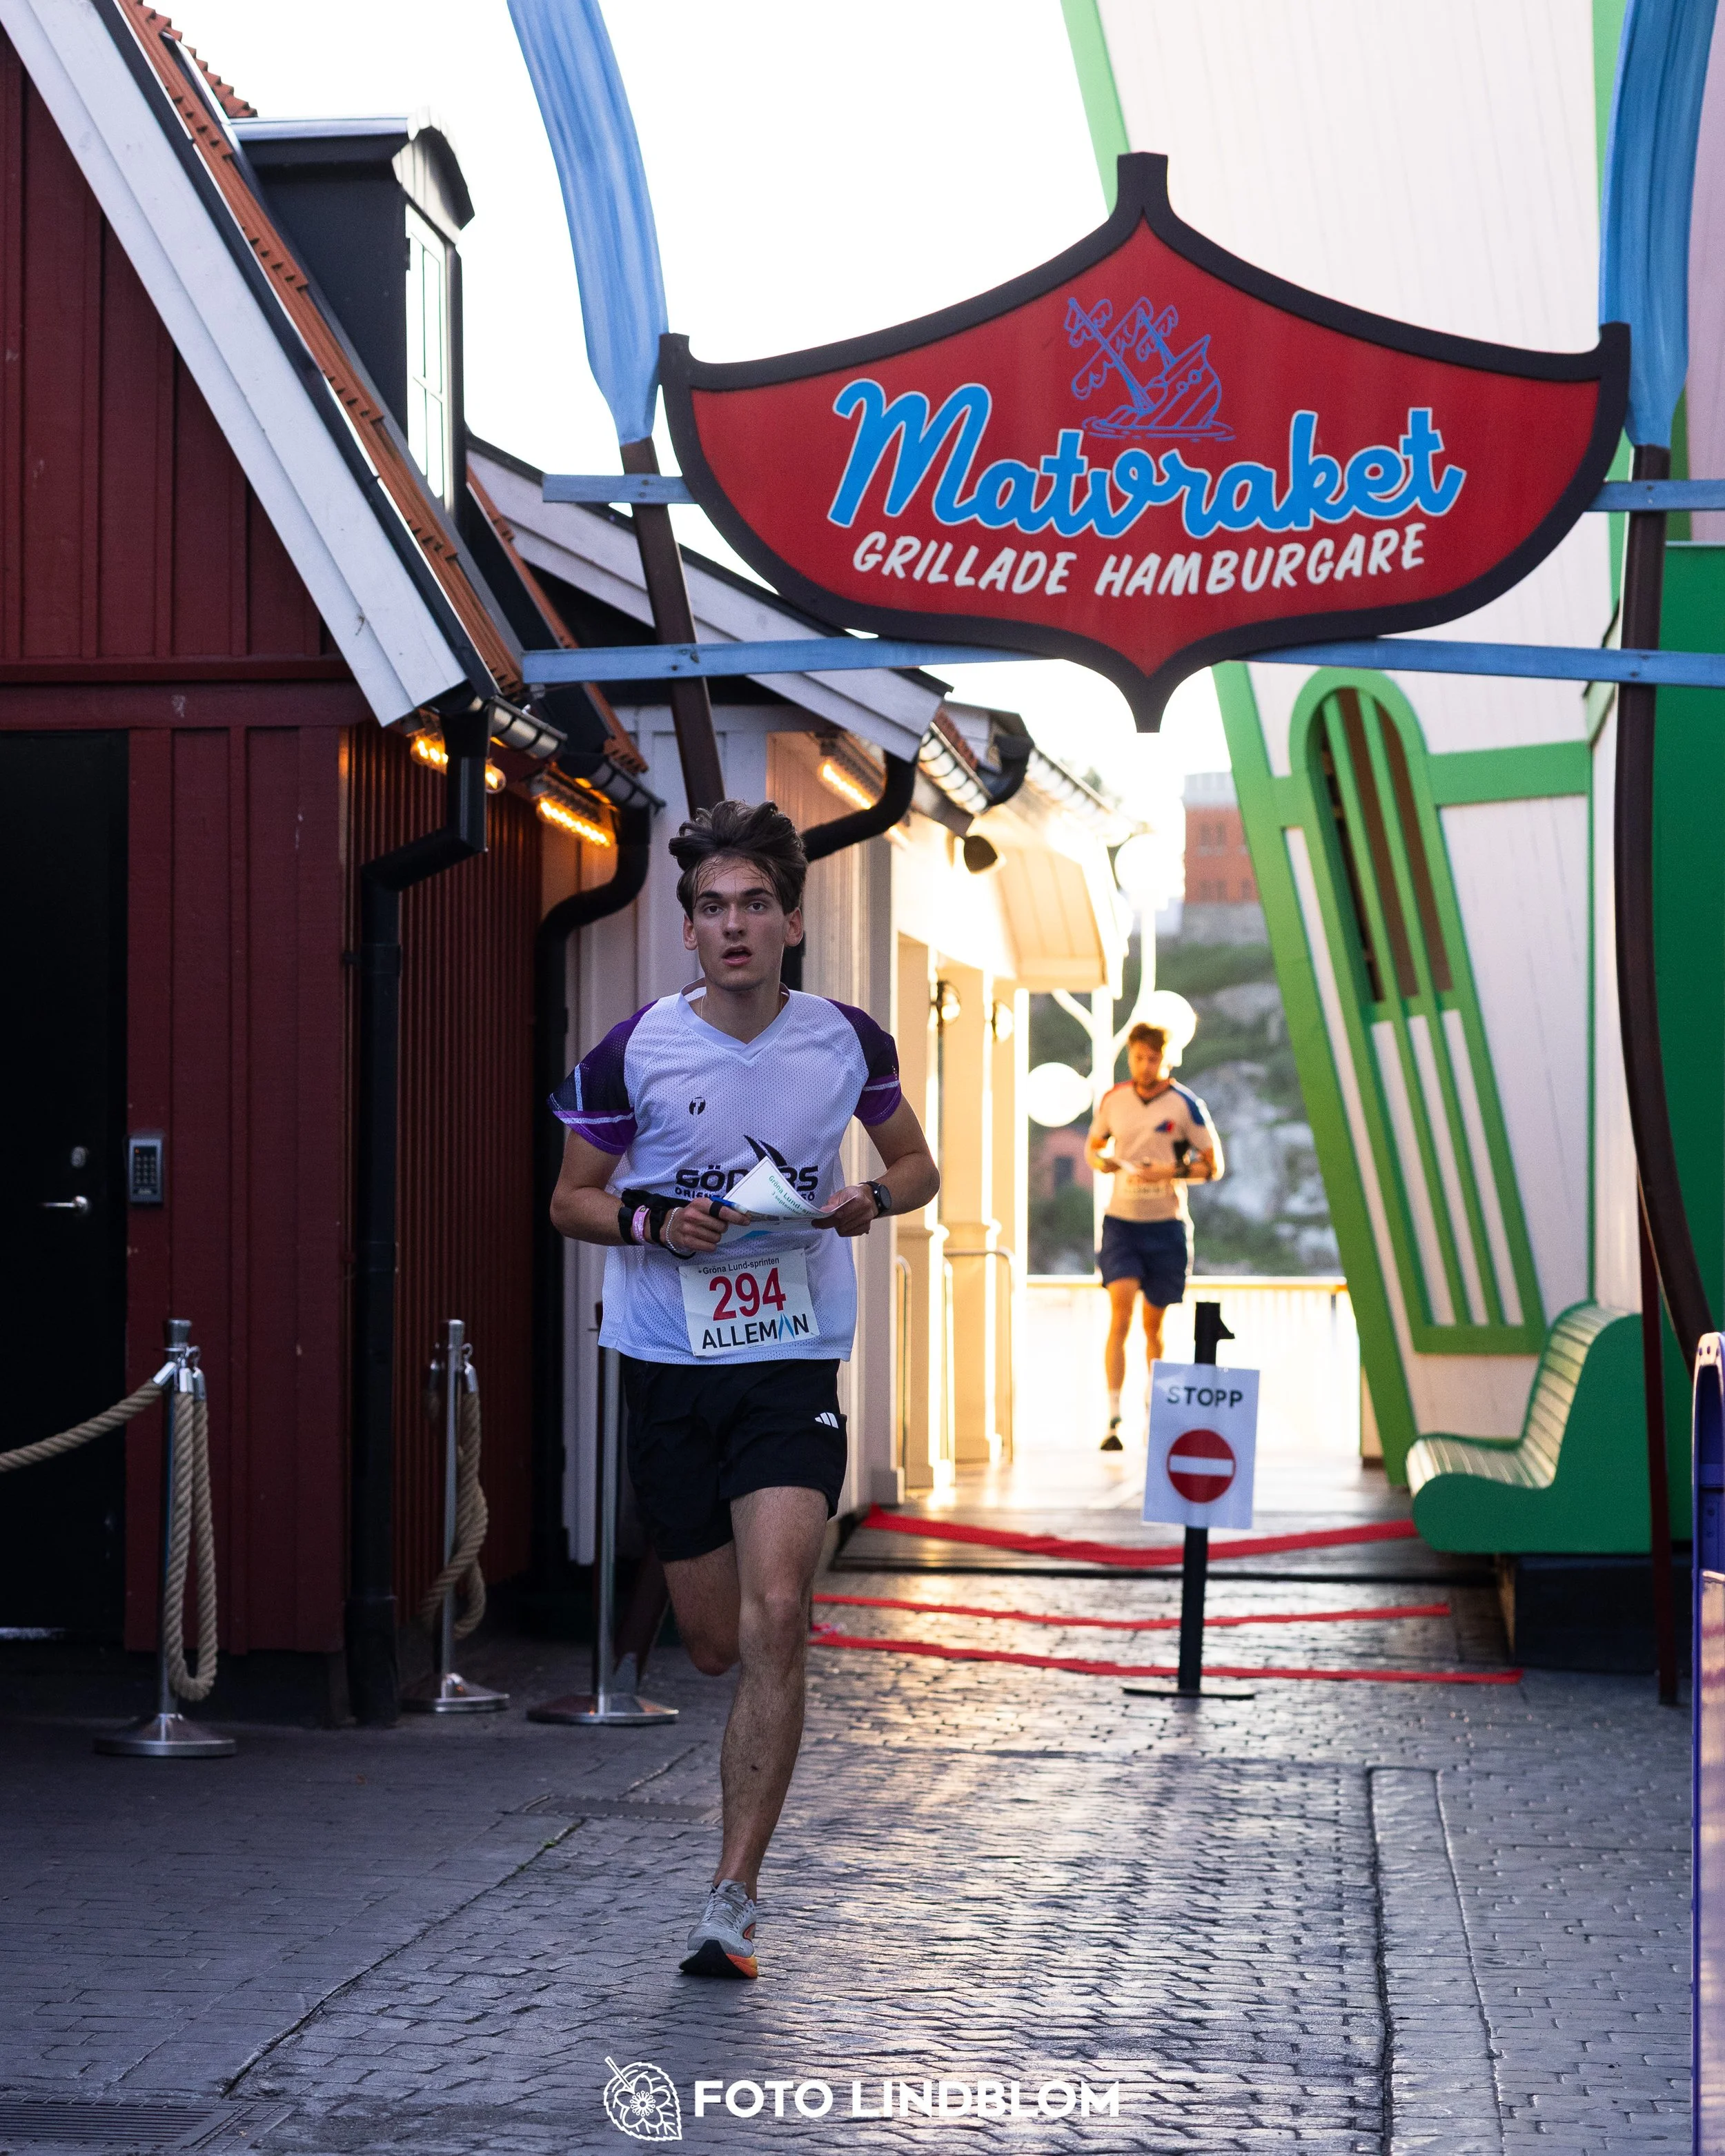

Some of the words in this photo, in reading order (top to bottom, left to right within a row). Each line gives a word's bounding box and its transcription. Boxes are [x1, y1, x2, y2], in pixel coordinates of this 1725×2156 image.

[828, 378, 1467, 539] Matvraket
[852, 531, 1077, 595] GRILLADE
[1094, 524, 1426, 597] HAMBURGARE
[769, 1175, 784, 1194] Gröna
[702, 1265, 727, 1275] Gröna
[728, 1257, 780, 1272] Lund-sprinten
[709, 1267, 787, 1321] 294
[1167, 1385, 1243, 1407] STOPP
